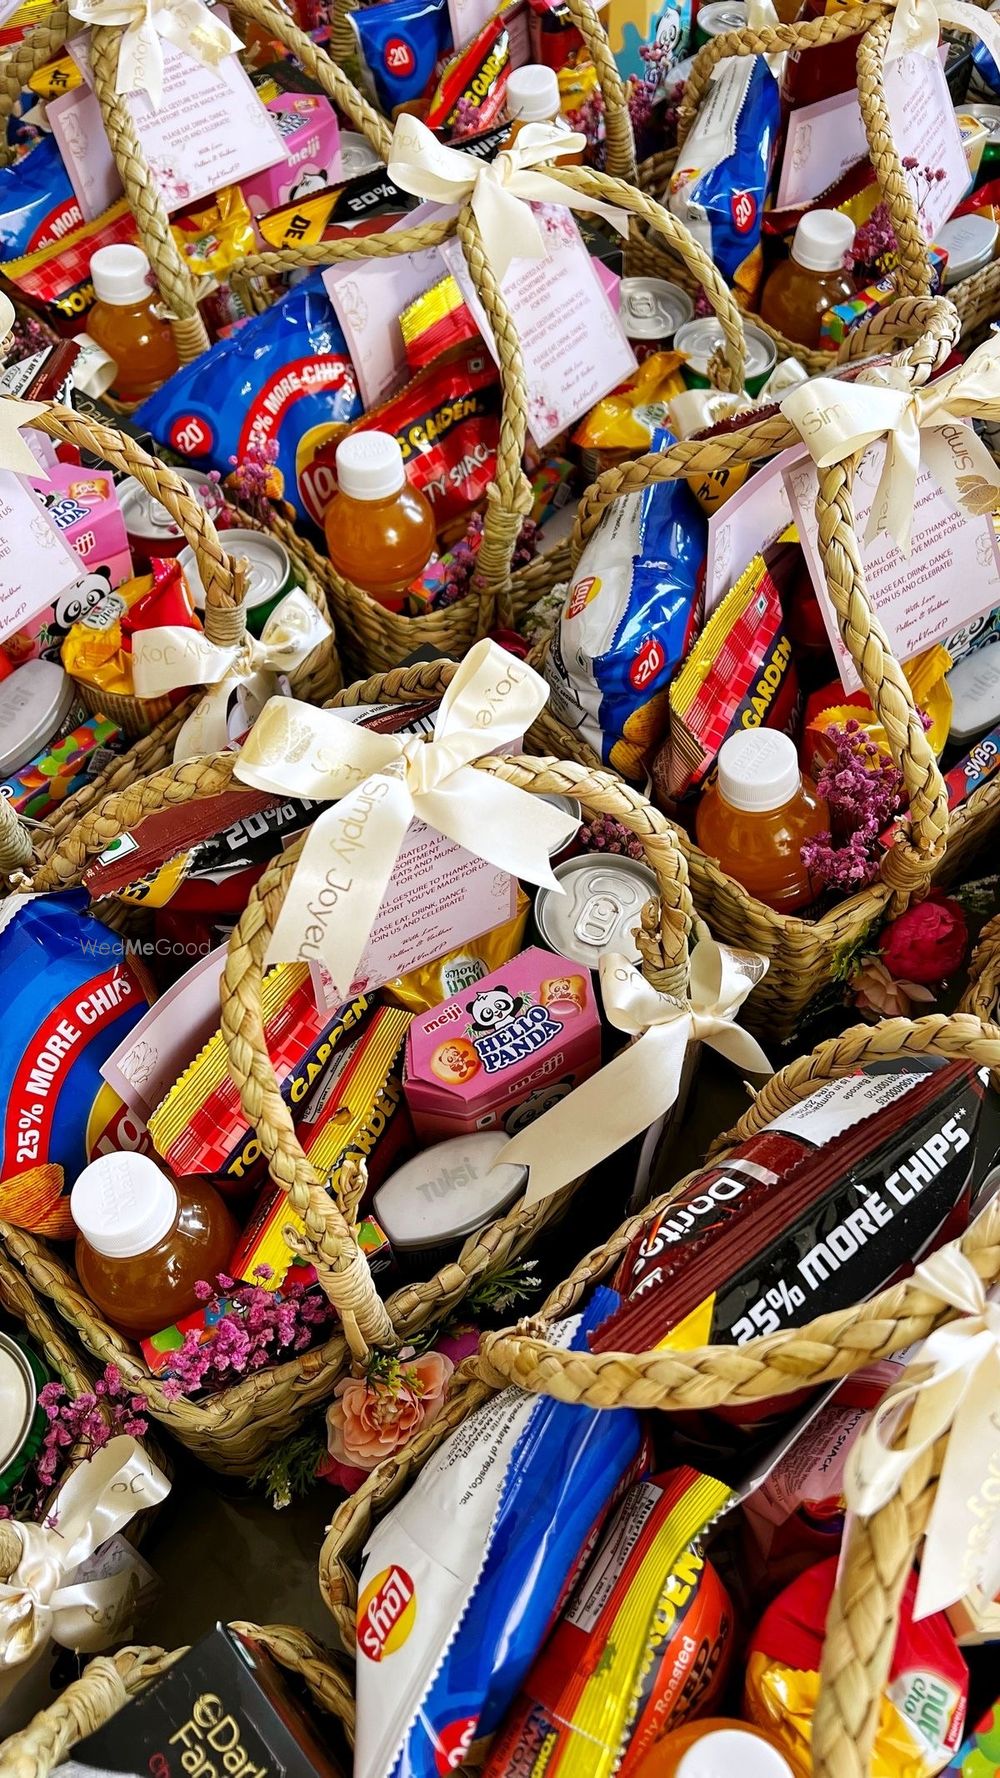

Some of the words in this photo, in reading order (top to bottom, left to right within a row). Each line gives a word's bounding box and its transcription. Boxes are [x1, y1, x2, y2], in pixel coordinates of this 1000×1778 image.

[288, 136, 321, 167] meiji
[347, 184, 398, 211] 20%
[263, 372, 301, 415] MORE
[863, 555, 884, 573] SMALL
[916, 531, 925, 542] TO
[927, 517, 948, 535] THANK
[948, 509, 960, 521] YOU
[873, 559, 896, 578] EFFORT
[923, 531, 942, 548] MADE
[943, 522, 957, 536] FOR
[875, 595, 890, 609] JOIN
[891, 589, 899, 600] US
[900, 579, 915, 594] AND
[742, 636, 791, 729] GARDEN
[964, 741, 998, 780] GEMS
[226, 803, 297, 852] 20%
[330, 781, 389, 865] Simply
[393, 882, 426, 904] GESTURE
[430, 876, 439, 886] TO
[442, 861, 468, 880] THANK
[396, 873, 413, 887] FOR
[408, 886, 434, 904] YOU'VE
[437, 874, 458, 890] MADE
[462, 865, 477, 878] FOR
[414, 856, 431, 871] AND
[371, 931, 388, 945] JOIN
[391, 926, 399, 935] US
[403, 916, 419, 929] AND
[422, 894, 464, 920] CELEBRATE!
[422, 1003, 464, 1034] meiji
[476, 1007, 548, 1056] HELLO
[25, 1018, 82, 1097] MORE
[290, 994, 370, 1104] GARDEN
[484, 1023, 561, 1072] PANDA
[508, 1052, 564, 1094] meiji
[842, 1078, 872, 1100] Barcode
[17, 1103, 45, 1163] 25%
[731, 1281, 806, 1347] 25%
[797, 1192, 894, 1288] MORE
[506, 1400, 524, 1424] Trade
[493, 1423, 511, 1445] Mark
[817, 1431, 846, 1474] SNACK
[467, 1453, 496, 1492] PepsiCo,
[458, 1486, 475, 1505] Inc.
[655, 1635, 697, 1714] Roasted
[207, 1714, 268, 1778] Dar
